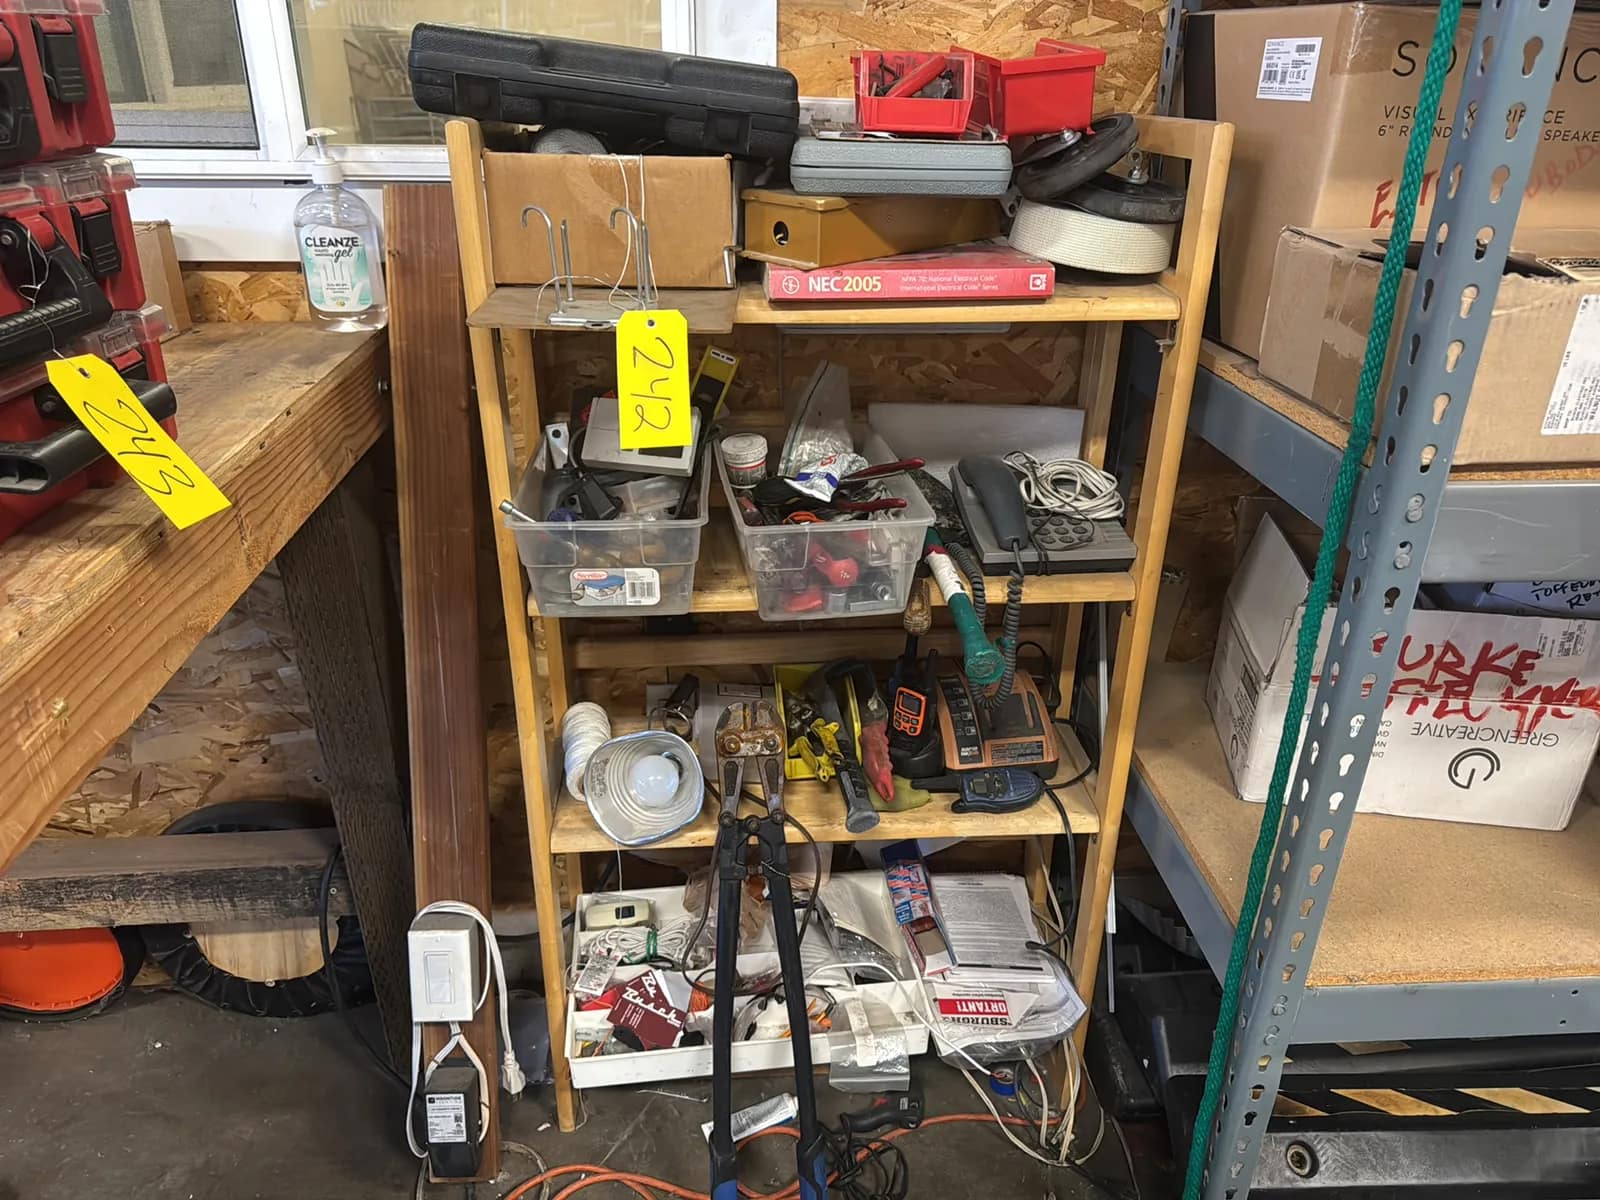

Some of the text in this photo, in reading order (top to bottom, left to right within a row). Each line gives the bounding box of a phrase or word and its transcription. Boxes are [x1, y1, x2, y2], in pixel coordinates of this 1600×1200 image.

[304, 236, 360, 248] CLEANZE
[334, 246, 353, 263] gel
[83, 398, 195, 495] 243
[1411, 721, 1559, 747] GREENCREATIVE
